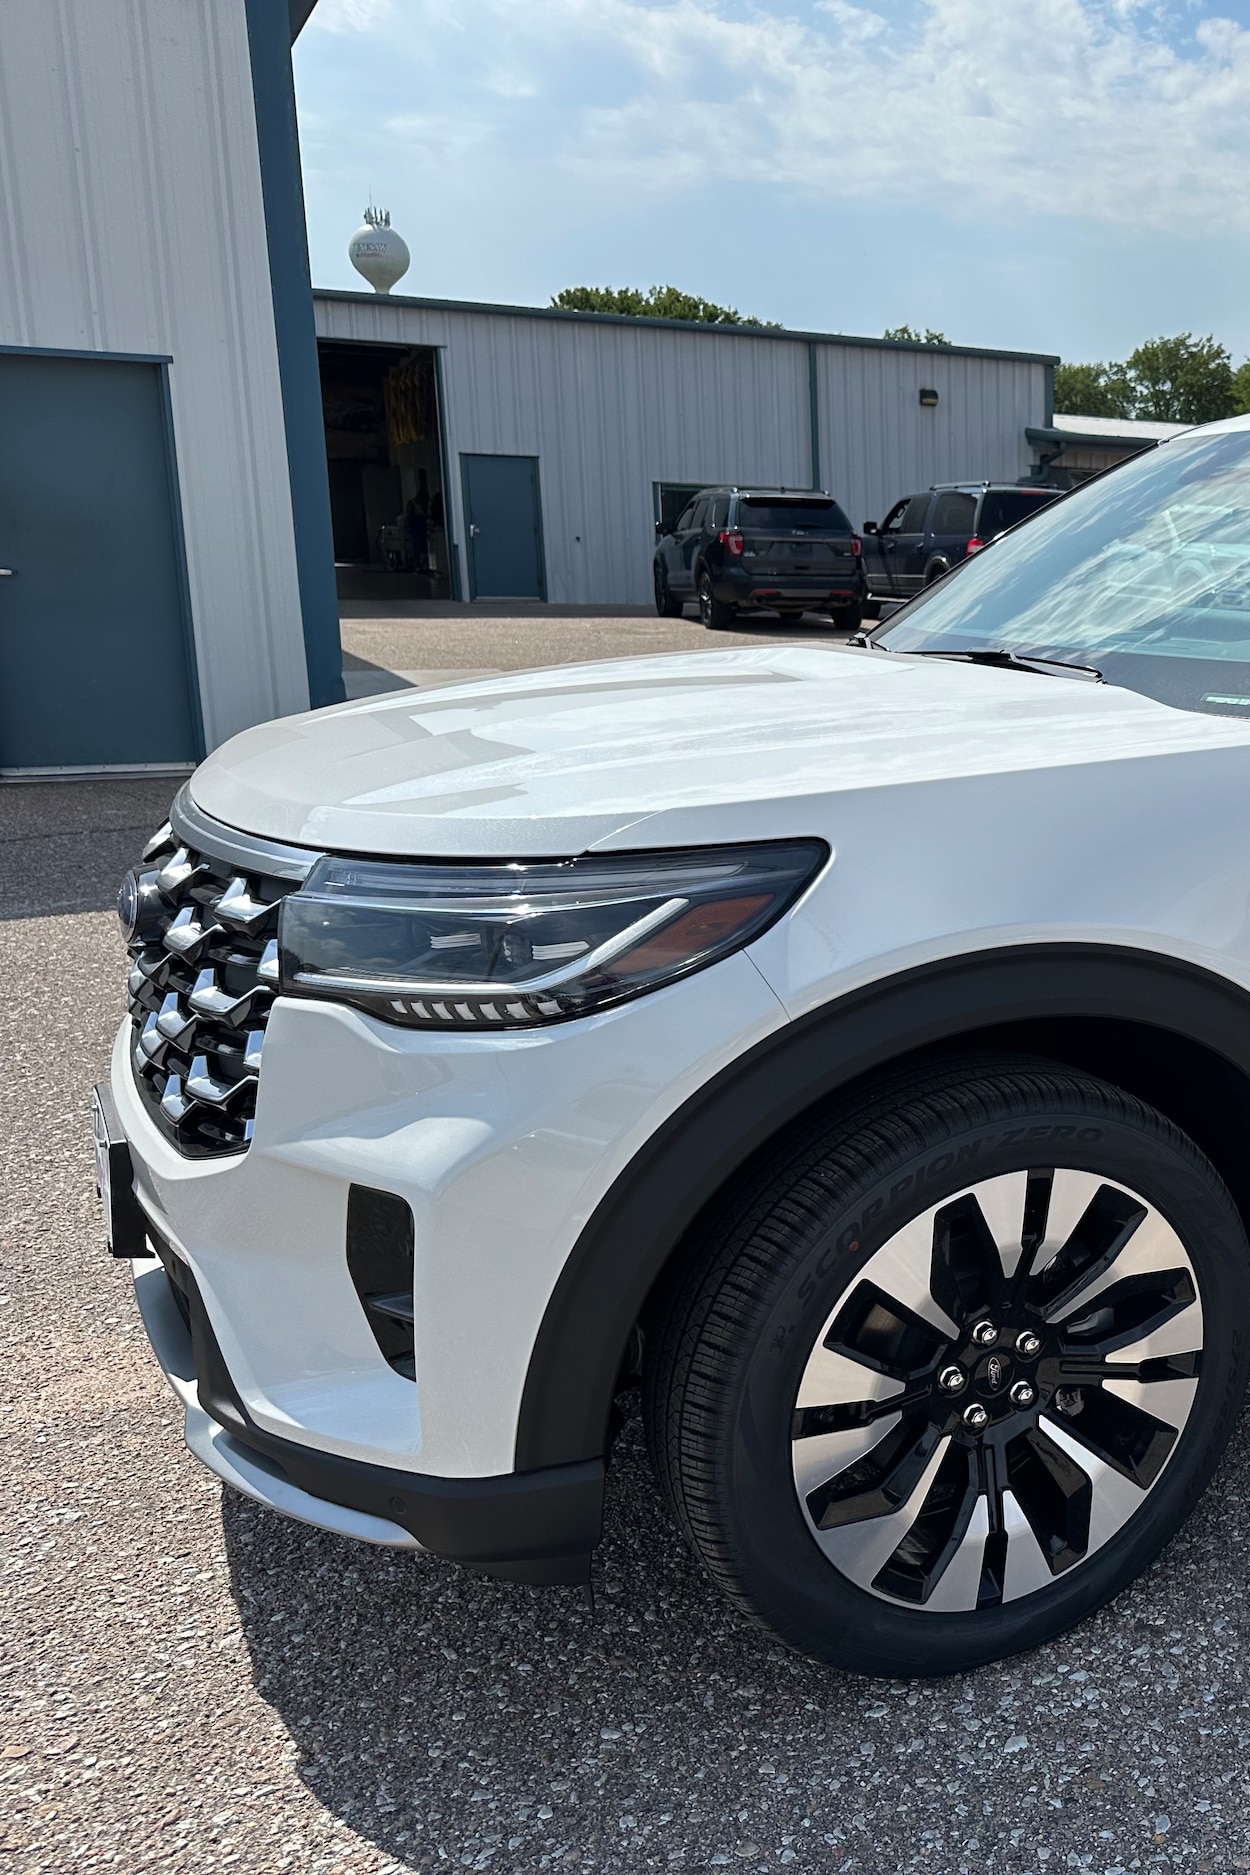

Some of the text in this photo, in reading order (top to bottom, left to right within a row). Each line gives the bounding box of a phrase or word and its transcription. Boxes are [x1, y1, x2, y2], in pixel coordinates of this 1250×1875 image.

[797, 1124, 1104, 1308] SCORPION ZERO
[990, 1363, 1000, 1385] Ford
